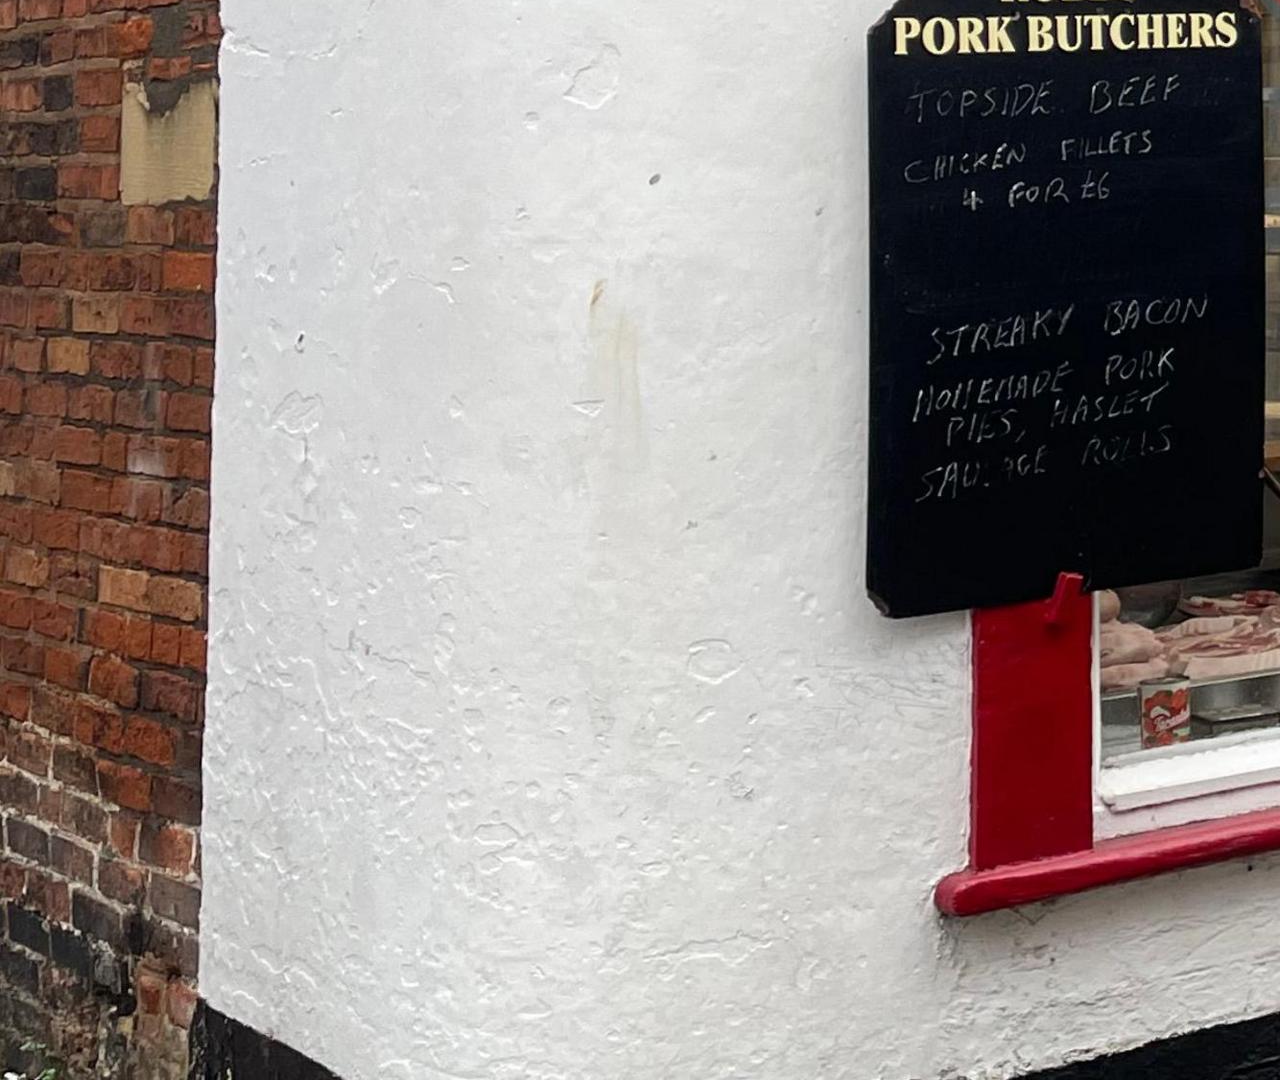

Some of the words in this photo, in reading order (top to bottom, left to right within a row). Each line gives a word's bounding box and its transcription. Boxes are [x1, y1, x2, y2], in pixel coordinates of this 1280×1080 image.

[894, 15, 1016, 56] PORK
[1026, 11, 1239, 52] BUTCHERS
[908, 80, 1055, 122] TOPSIDE
[1089, 74, 1181, 114] BEEF
[904, 142, 1027, 183] CHICKEN
[1061, 130, 1153, 162] FILLETS
[962, 188, 984, 211] 4
[1008, 177, 1069, 208] FOR
[1080, 170, 1111, 201] £6
[926, 302, 1075, 365] STREAKY
[1104, 293, 1209, 335] BACON
[912, 360, 1074, 422] HOMEMADE
[1104, 347, 1176, 385] PORK
[1050, 382, 1170, 428] HASLET
